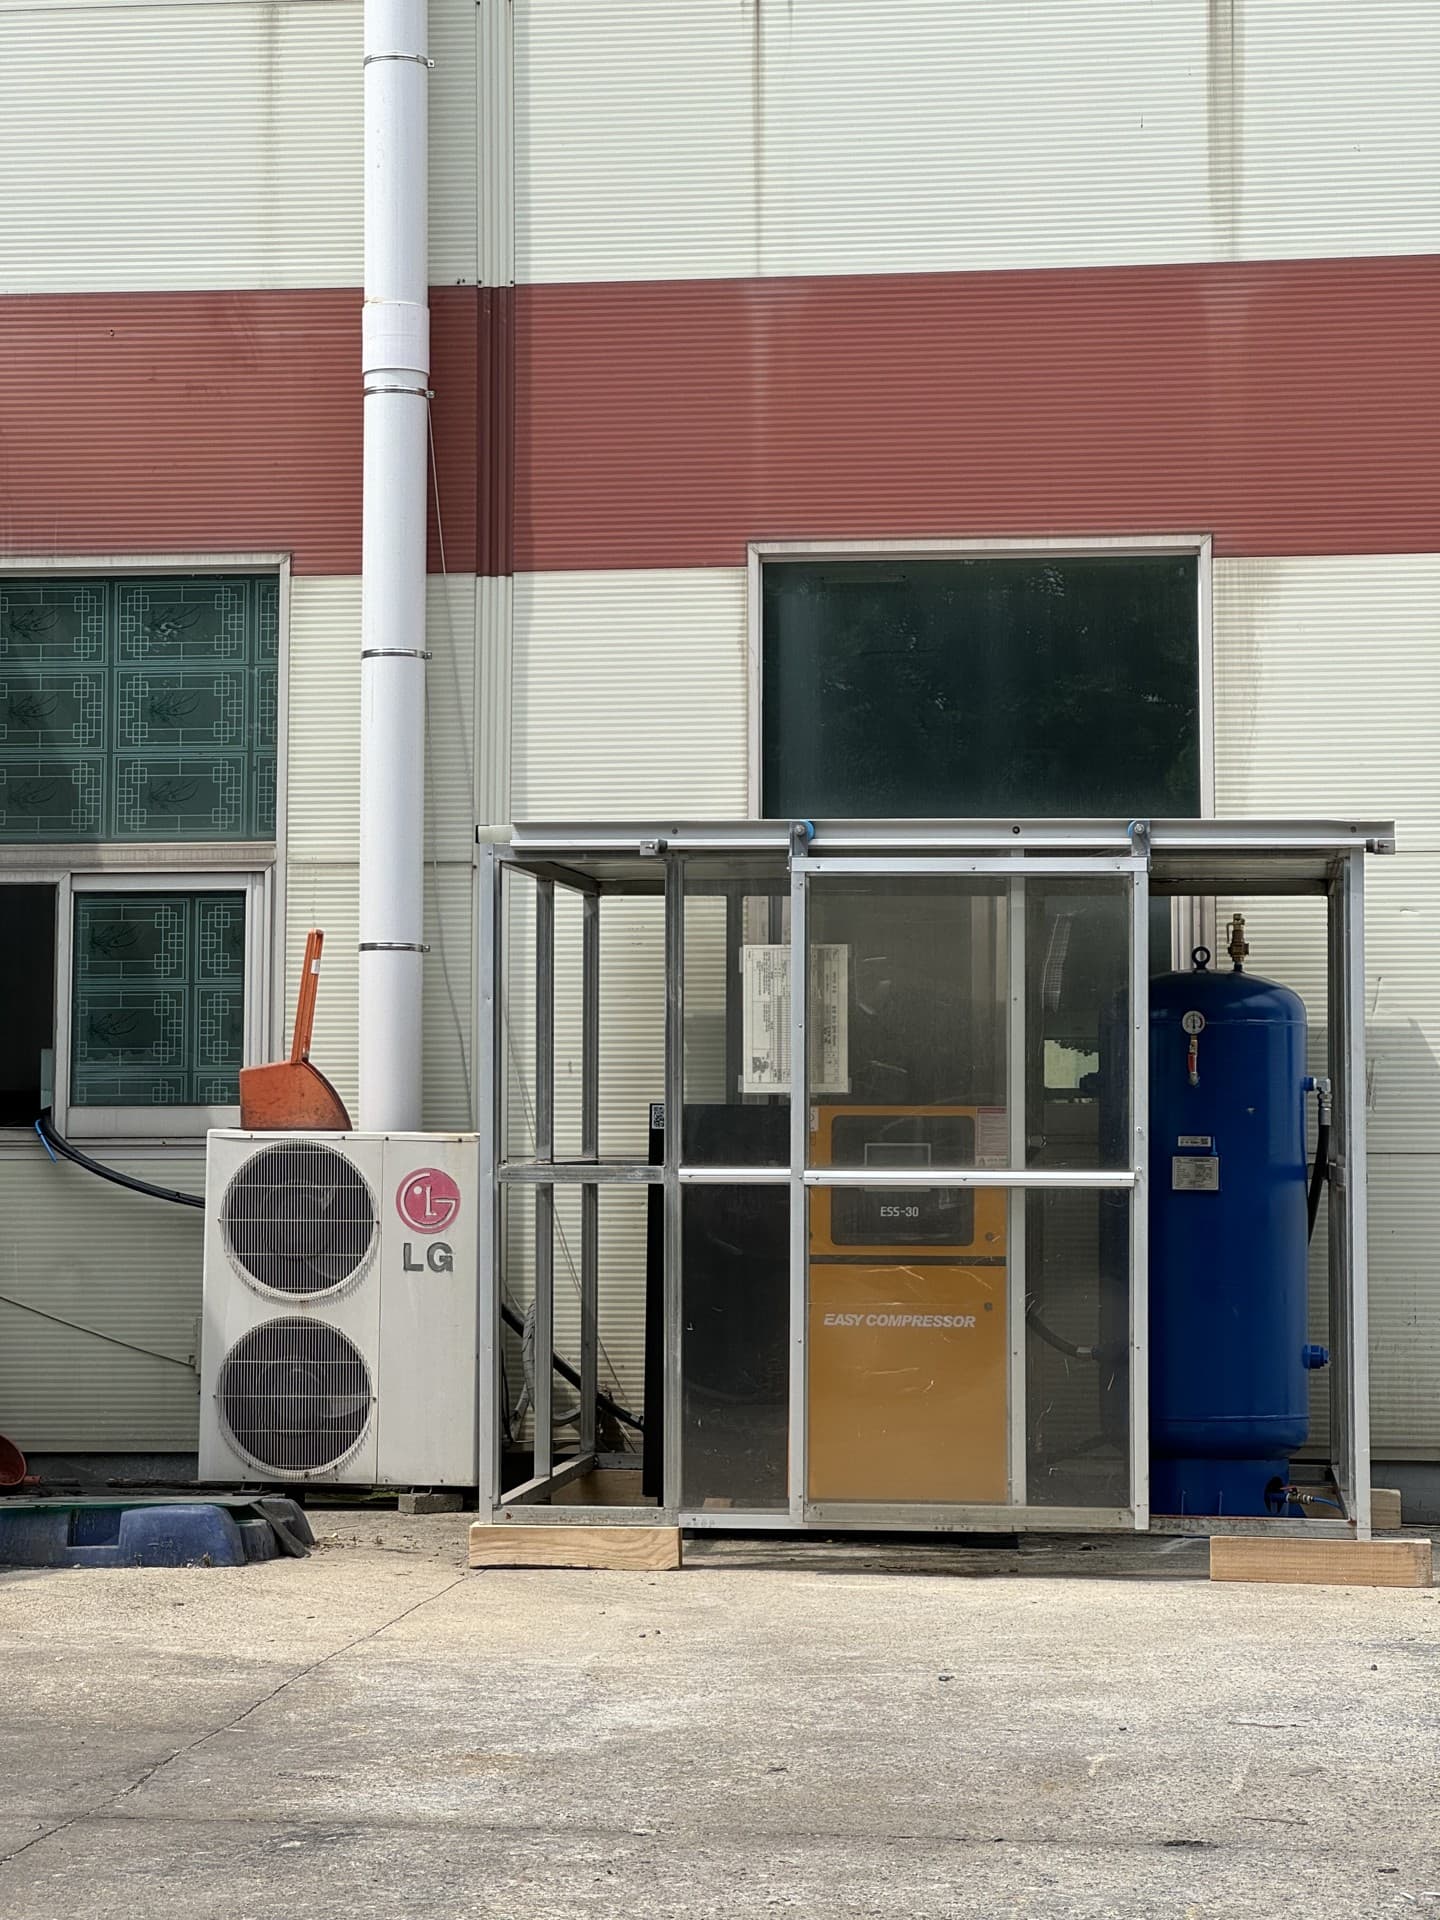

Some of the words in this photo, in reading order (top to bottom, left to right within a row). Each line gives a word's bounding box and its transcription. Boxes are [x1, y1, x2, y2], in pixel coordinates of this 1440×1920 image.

[880, 1206, 919, 1217] ESS-30
[403, 1242, 454, 1272] LG
[824, 1313, 864, 1326] EASY
[866, 1314, 976, 1328] COMPRESSOR
